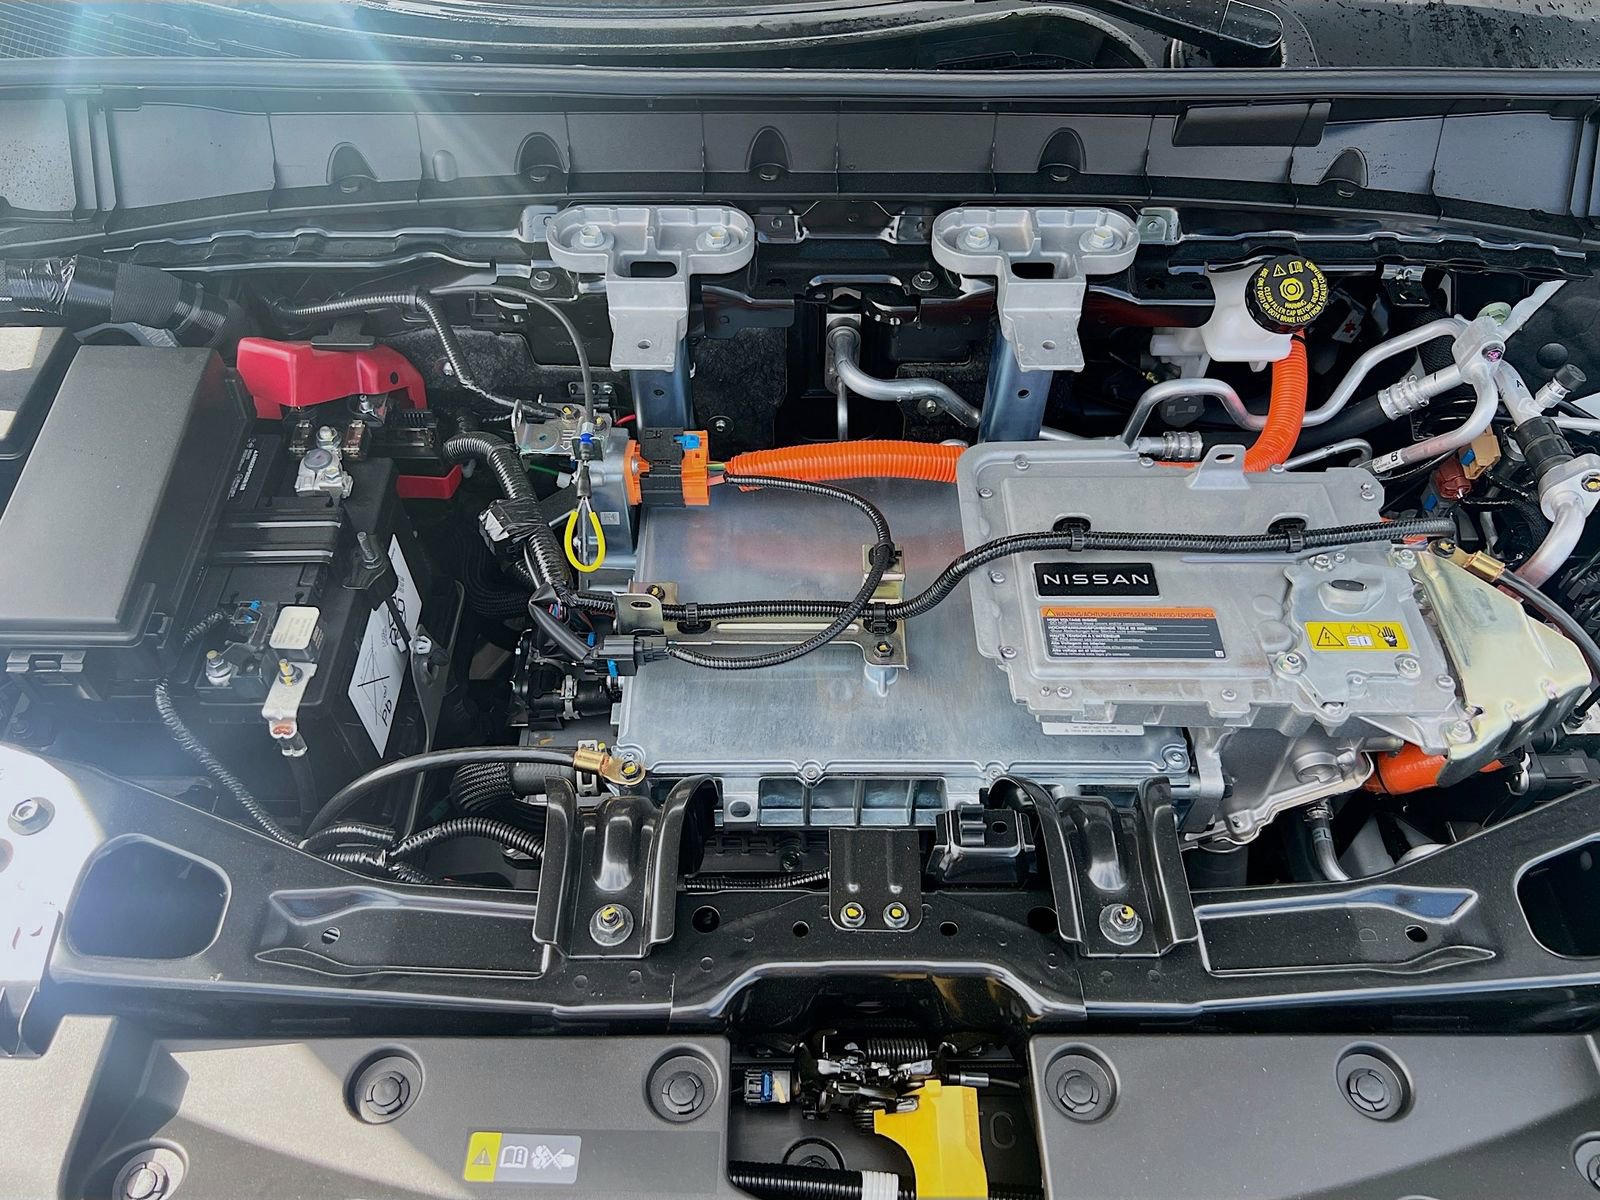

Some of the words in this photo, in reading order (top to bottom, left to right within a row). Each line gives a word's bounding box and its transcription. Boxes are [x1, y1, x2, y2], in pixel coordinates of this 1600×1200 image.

[1305, 260, 1325, 283] CONTAINER
[1264, 287, 1274, 303] CLEAN
[1270, 301, 1286, 315] FILLER
[1296, 302, 1315, 316] BEFORE
[1310, 278, 1320, 303] REMOVING
[1284, 299, 1307, 309] WARNING
[1268, 309, 1279, 320] DOT4
[1309, 305, 1322, 317] FROM
[1280, 315, 1296, 323] BRAKE
[1296, 314, 1311, 323] FLUID
[1043, 574, 1149, 585] NISSAN
[382, 699, 392, 727] Pb
